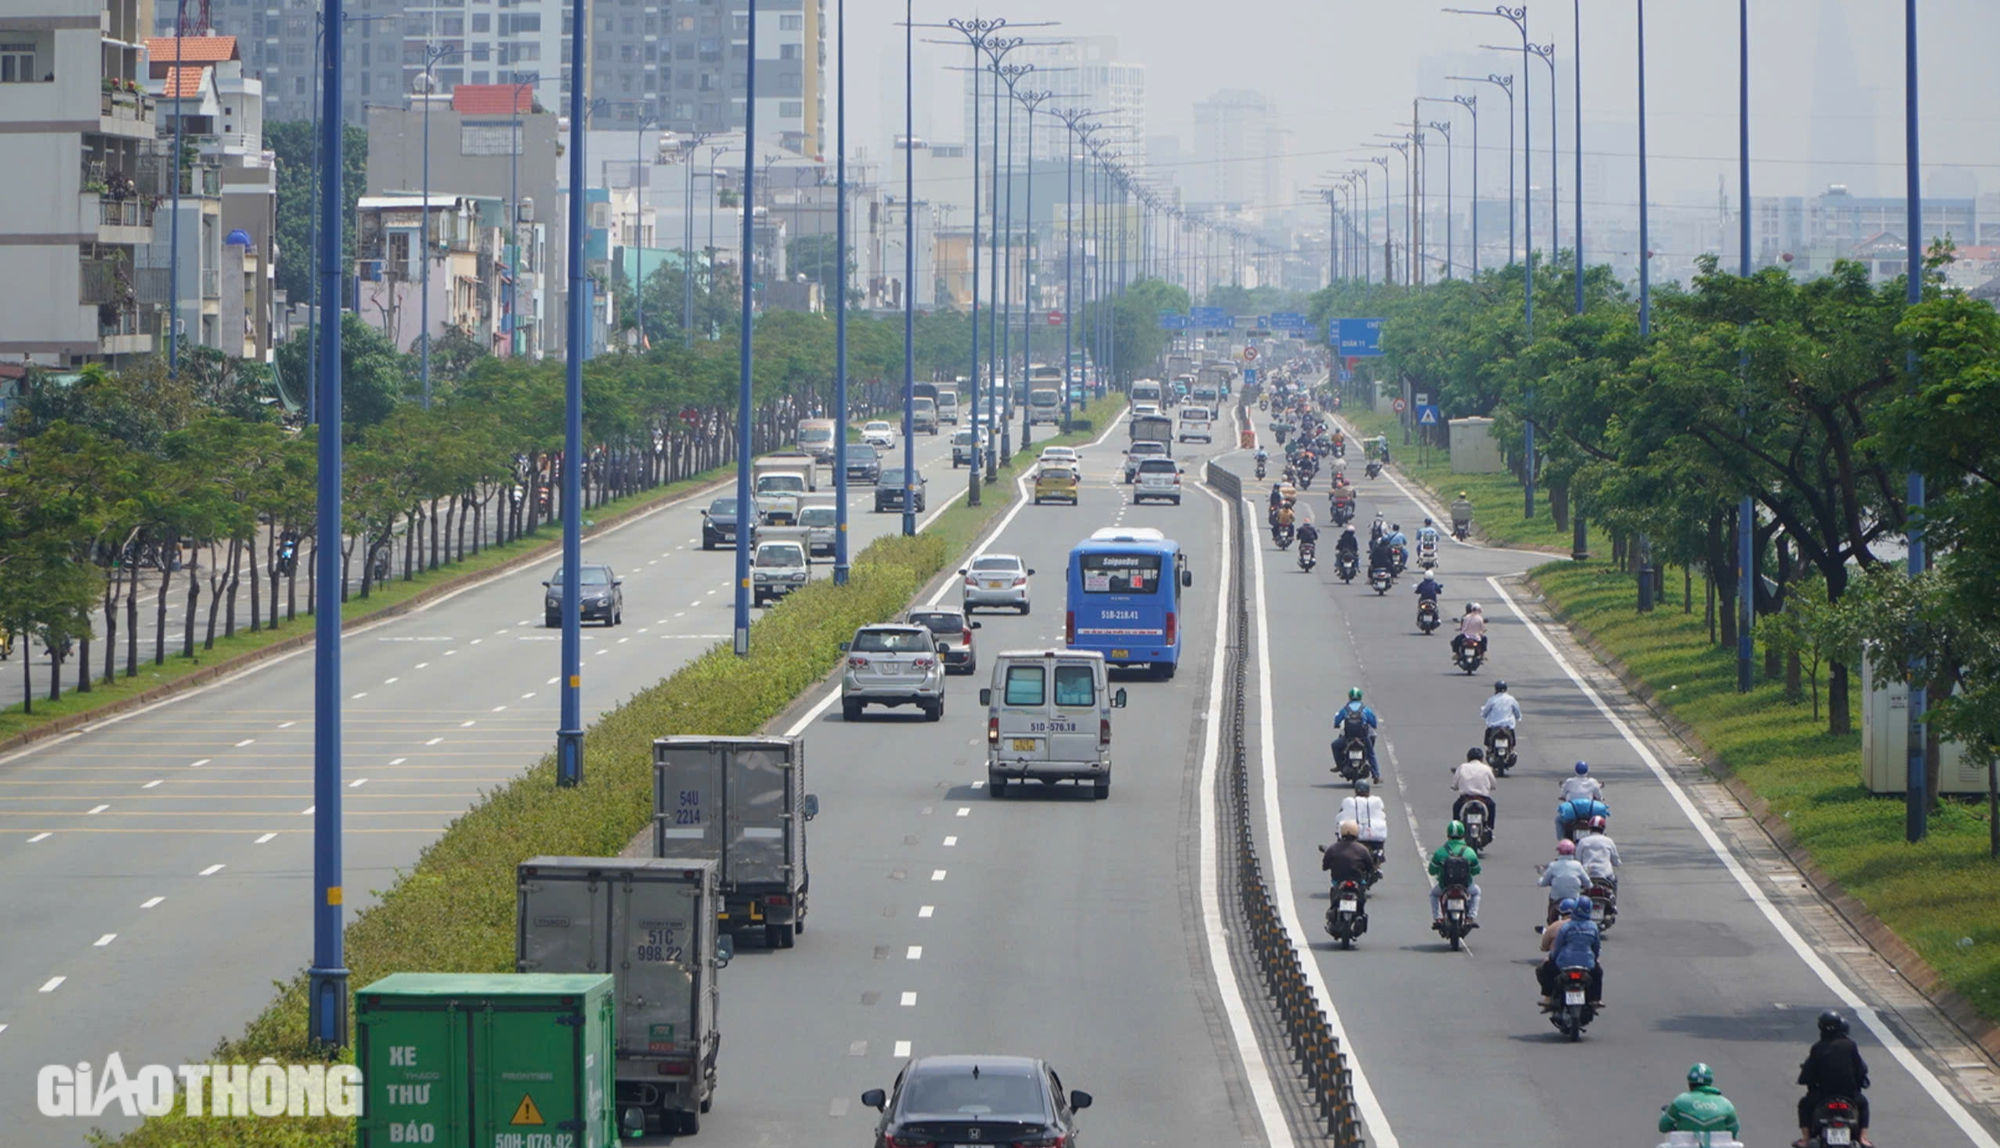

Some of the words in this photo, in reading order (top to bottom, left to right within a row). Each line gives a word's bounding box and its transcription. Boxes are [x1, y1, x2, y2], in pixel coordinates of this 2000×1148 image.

[1102, 557, 1139, 567] SaigonBus
[1101, 610, 1139, 620] 51B-218.41
[679, 790, 699, 807] 54U
[676, 809, 701, 825] 2214
[648, 929, 674, 945] 51C
[637, 945, 683, 962] 998.22
[389, 1046, 417, 1066] XE
[403, 1071, 441, 1080] THACO
[501, 1071, 553, 1081] FRONTIER
[387, 1083, 431, 1104] THƯ
[1692, 1101, 1718, 1111] Grab
[389, 1120, 435, 1143] BÁO
[495, 1133, 573, 1148] 50H-078.92
